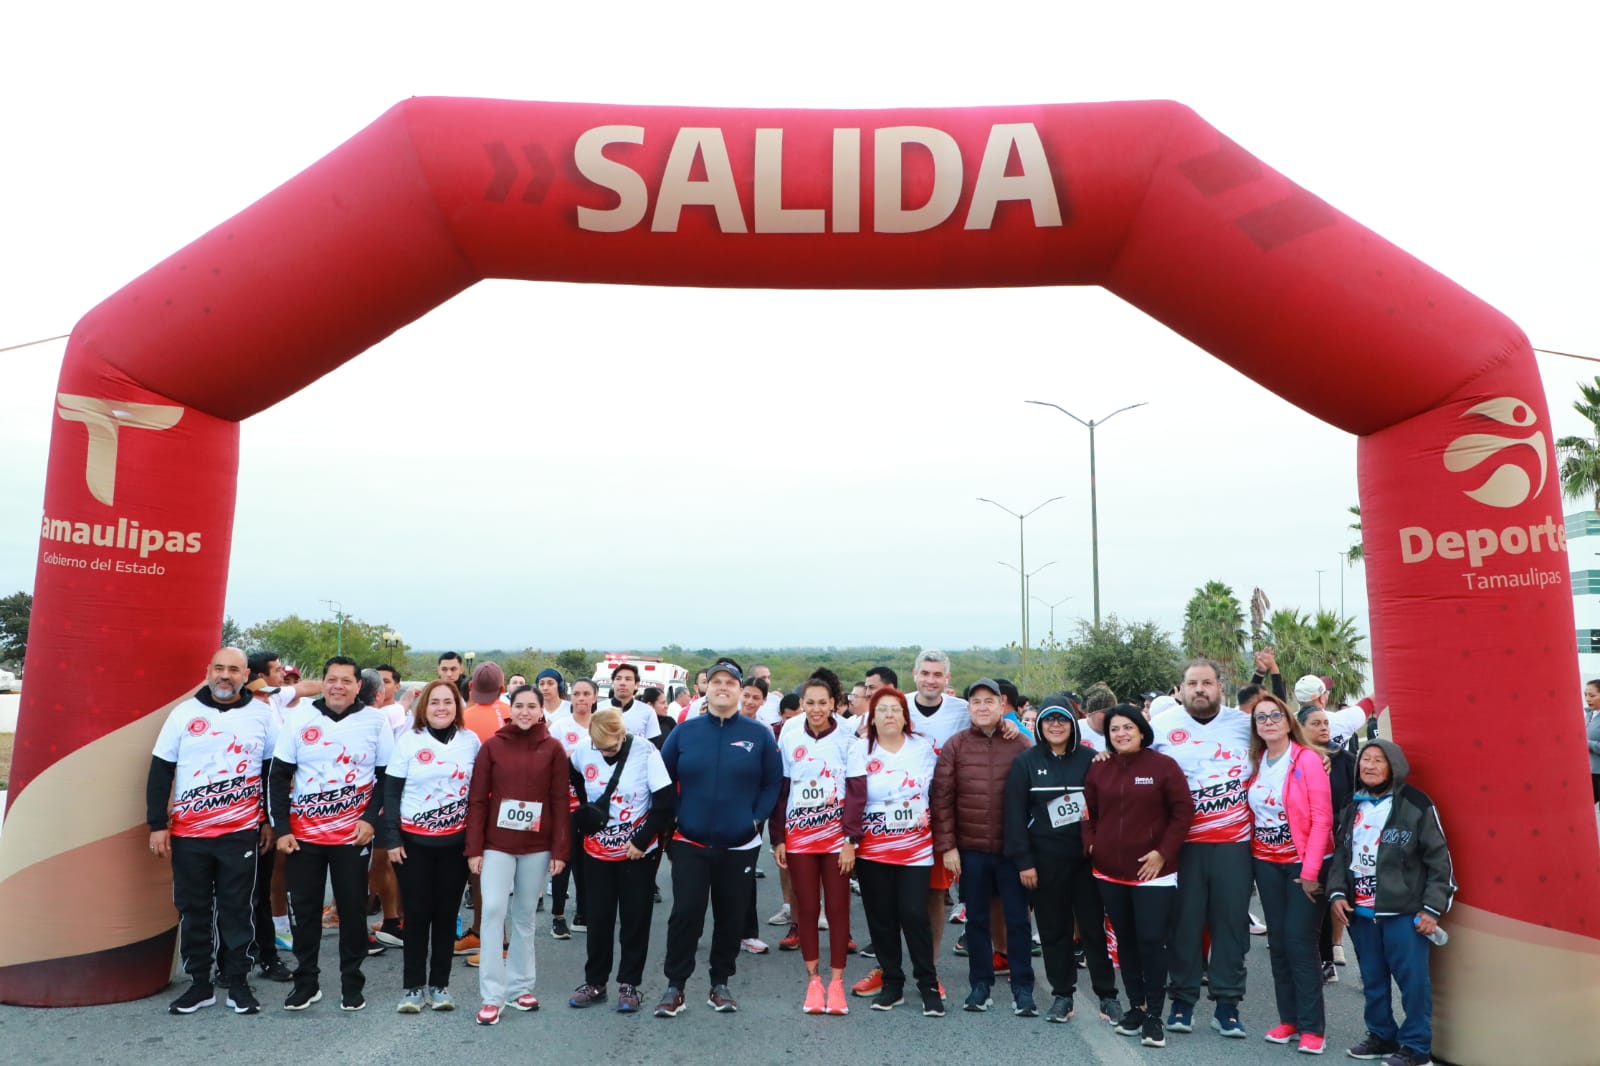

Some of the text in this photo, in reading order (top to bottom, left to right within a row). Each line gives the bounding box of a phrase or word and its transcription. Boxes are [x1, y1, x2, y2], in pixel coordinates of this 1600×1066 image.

[574, 122, 1063, 233] SALIDA
[41, 513, 202, 558] amaulipas
[1399, 515, 1566, 568] Deporte
[43, 551, 166, 575] Gobierno del Estado
[1461, 567, 1562, 591] Tamaulipas
[180, 784, 257, 816] Y CAMINATA
[181, 775, 246, 802] CARRERA
[297, 784, 356, 805] CARRERA
[802, 787, 825, 800] 001
[507, 808, 534, 823] 009
[894, 808, 913, 821] 011
[1057, 801, 1080, 817] 033
[1358, 852, 1376, 867] 165
